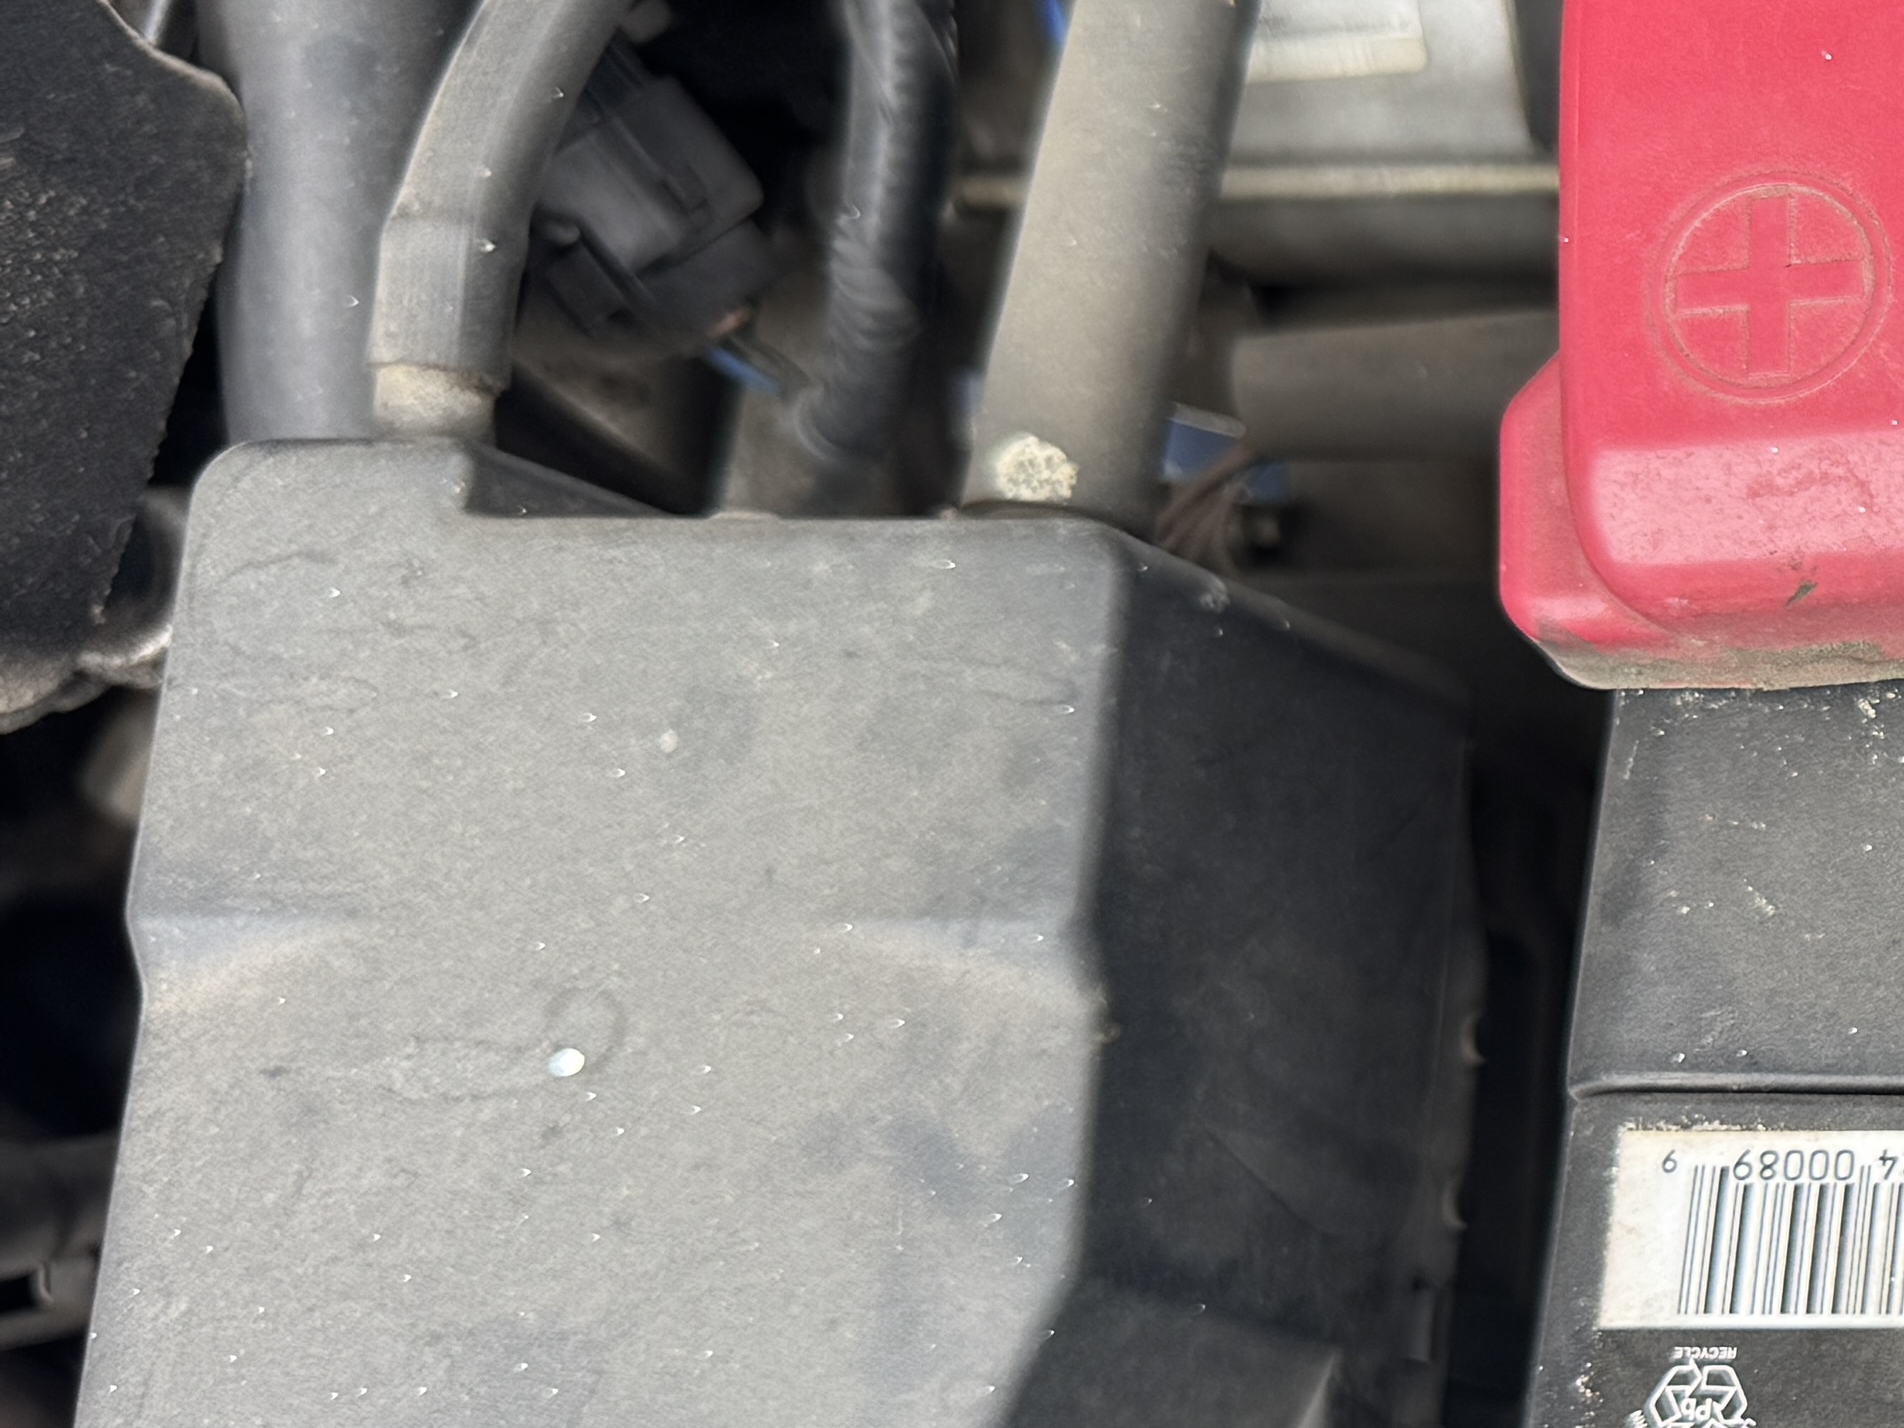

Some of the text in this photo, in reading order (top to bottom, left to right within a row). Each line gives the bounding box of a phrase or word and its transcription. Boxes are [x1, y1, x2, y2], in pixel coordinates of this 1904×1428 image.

[1661, 1149, 1678, 1174] 9
[1732, 1148, 1855, 1181] 00089
[1673, 1346, 1737, 1359] RECYCLE
[1681, 1398, 1712, 1420] Pb
